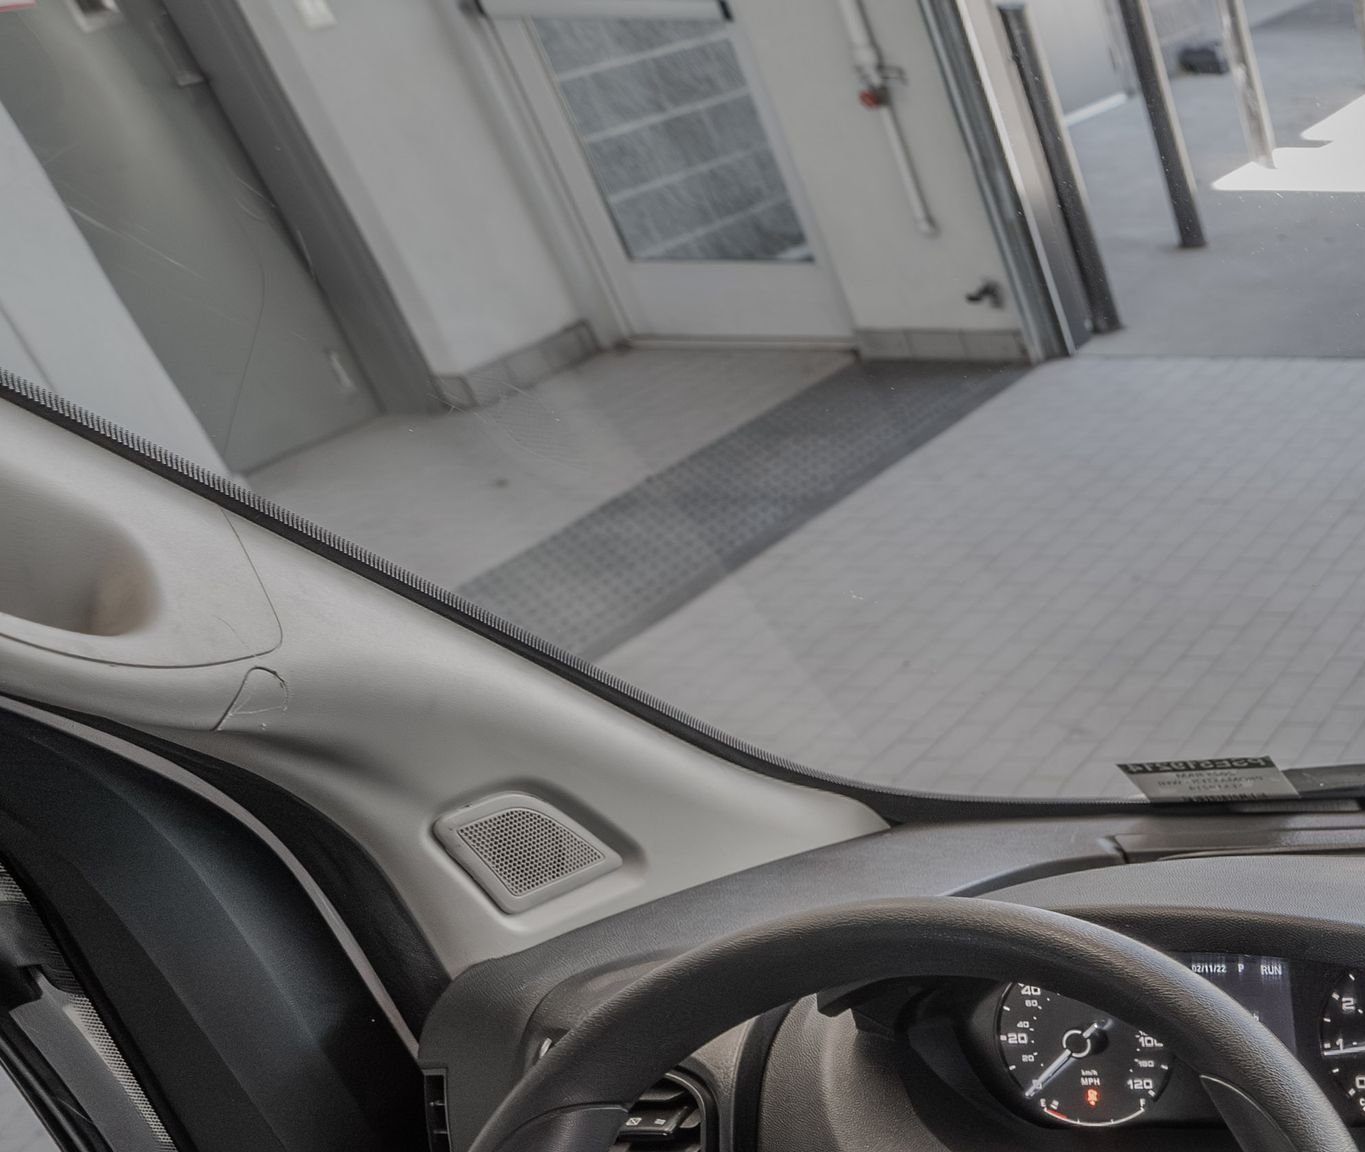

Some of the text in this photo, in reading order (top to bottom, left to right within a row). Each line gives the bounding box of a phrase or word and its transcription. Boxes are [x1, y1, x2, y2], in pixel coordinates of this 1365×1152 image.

[1238, 964, 1244, 972] P
[1260, 964, 1282, 976] RUN
[1021, 986, 1041, 996] 40
[1342, 997, 1356, 1010] 2
[1007, 1033, 1028, 1044] 20
[1336, 1038, 1344, 1050] 1
[1081, 1077, 1100, 1086] MPH
[1127, 1079, 1153, 1090] 120
[1040, 1098, 1046, 1108] E
[1140, 1098, 1146, 1108] F
[1359, 1098, 1365, 1106] C
